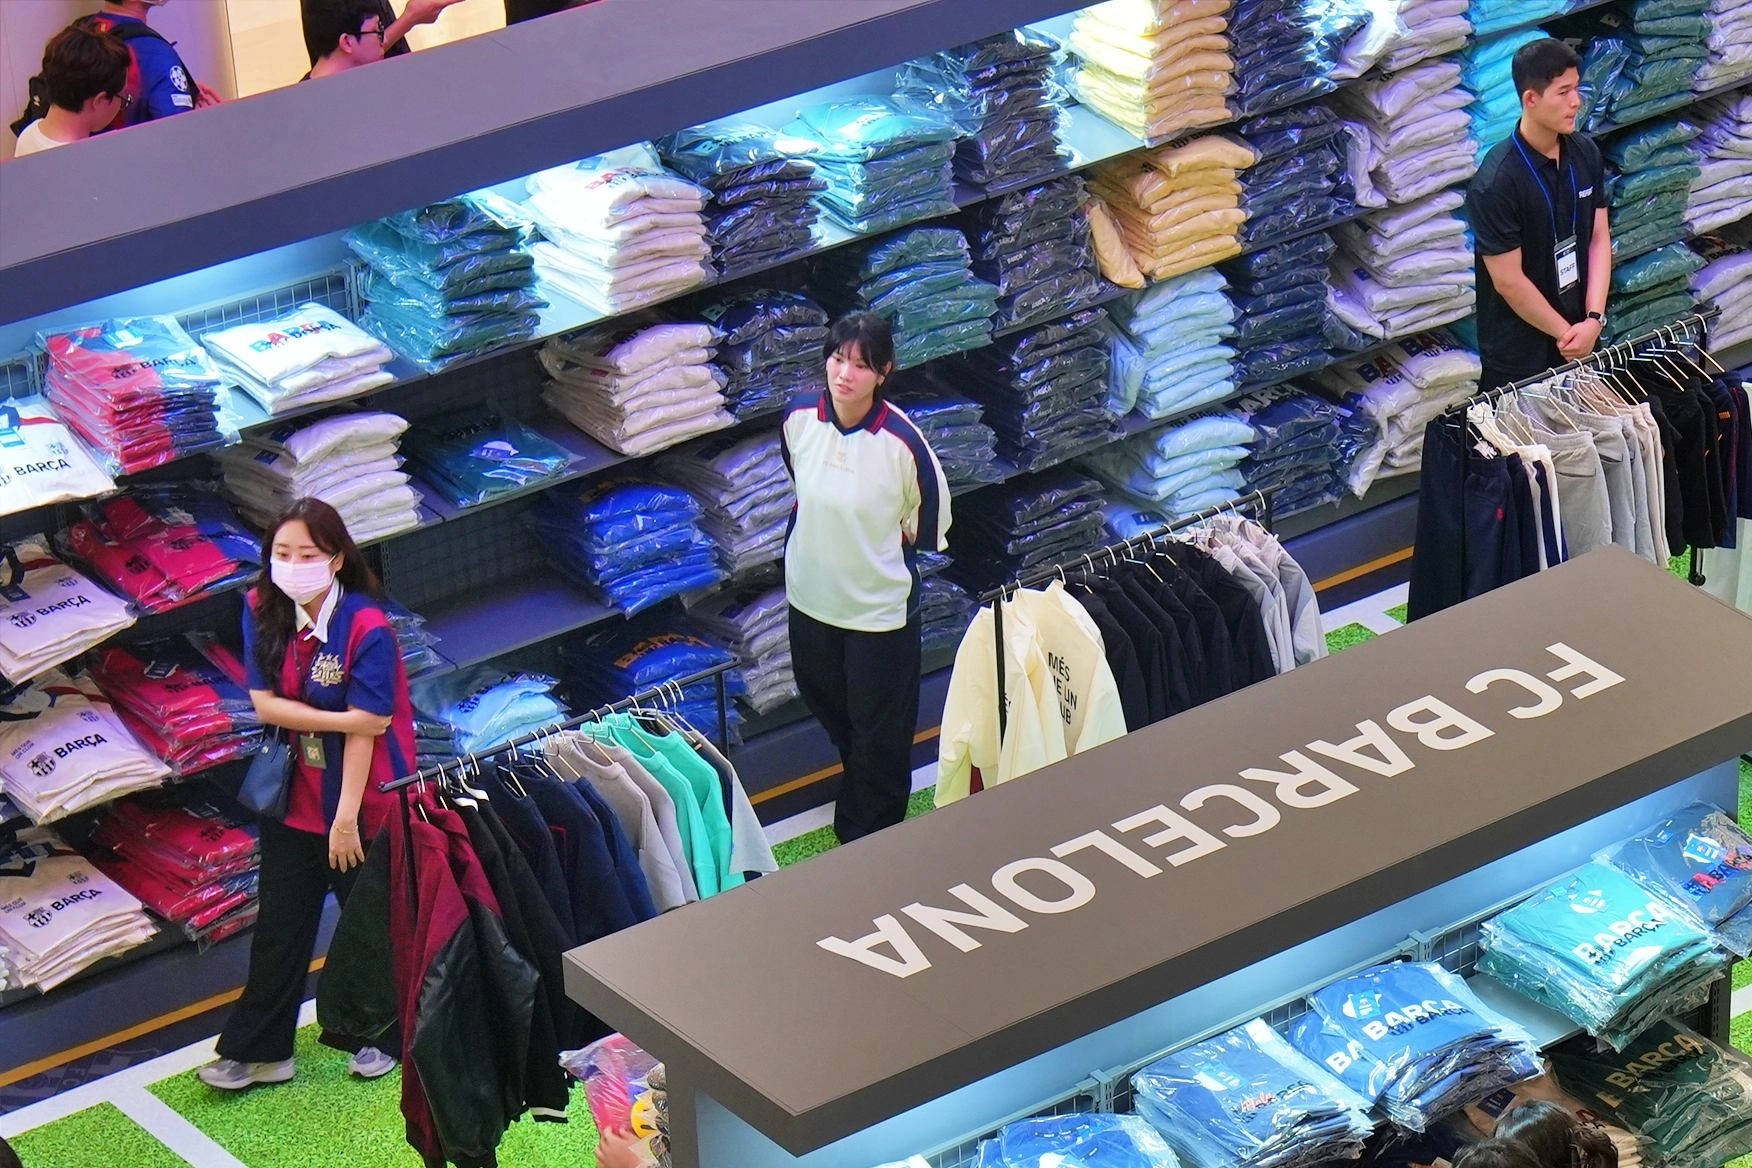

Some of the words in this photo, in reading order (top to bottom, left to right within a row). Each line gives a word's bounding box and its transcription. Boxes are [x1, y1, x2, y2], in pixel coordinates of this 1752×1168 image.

[1559, 262, 1576, 276] STAFF
[14, 458, 71, 476] BARÇA
[36, 594, 91, 617] BARÇA
[1048, 652, 1070, 683] MÉS
[1465, 641, 1626, 725] FC
[54, 732, 107, 759] BARÇA
[816, 693, 1495, 979] BARCELONA
[51, 888, 103, 913] BARÇA
